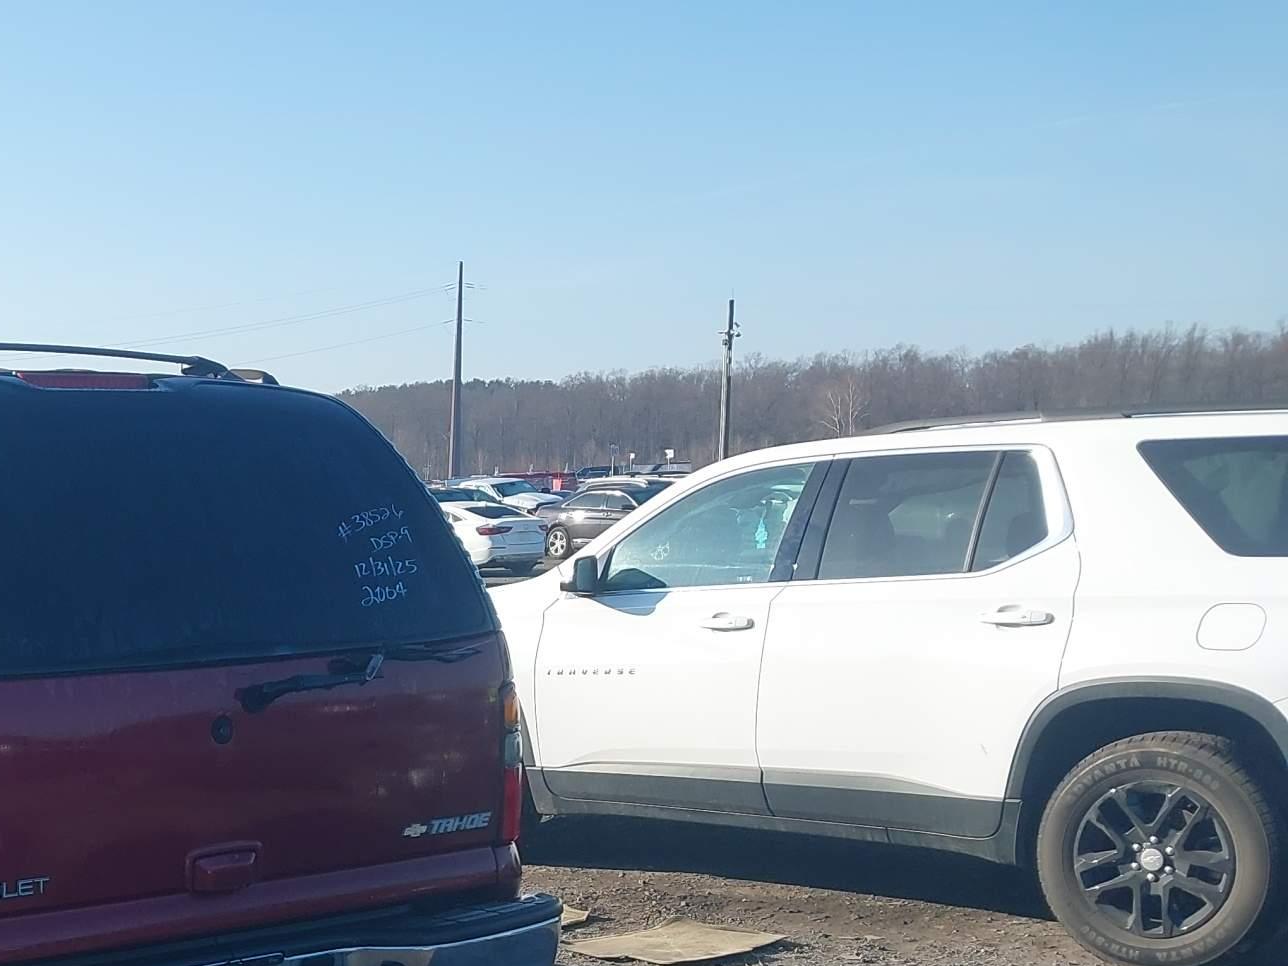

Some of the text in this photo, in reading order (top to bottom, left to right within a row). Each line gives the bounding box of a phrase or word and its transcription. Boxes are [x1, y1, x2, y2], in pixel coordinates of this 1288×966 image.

[337, 503, 404, 544] #38526
[354, 556, 418, 578] 12/31/25
[361, 582, 408, 606] 2004
[429, 811, 492, 835] TAHOE
